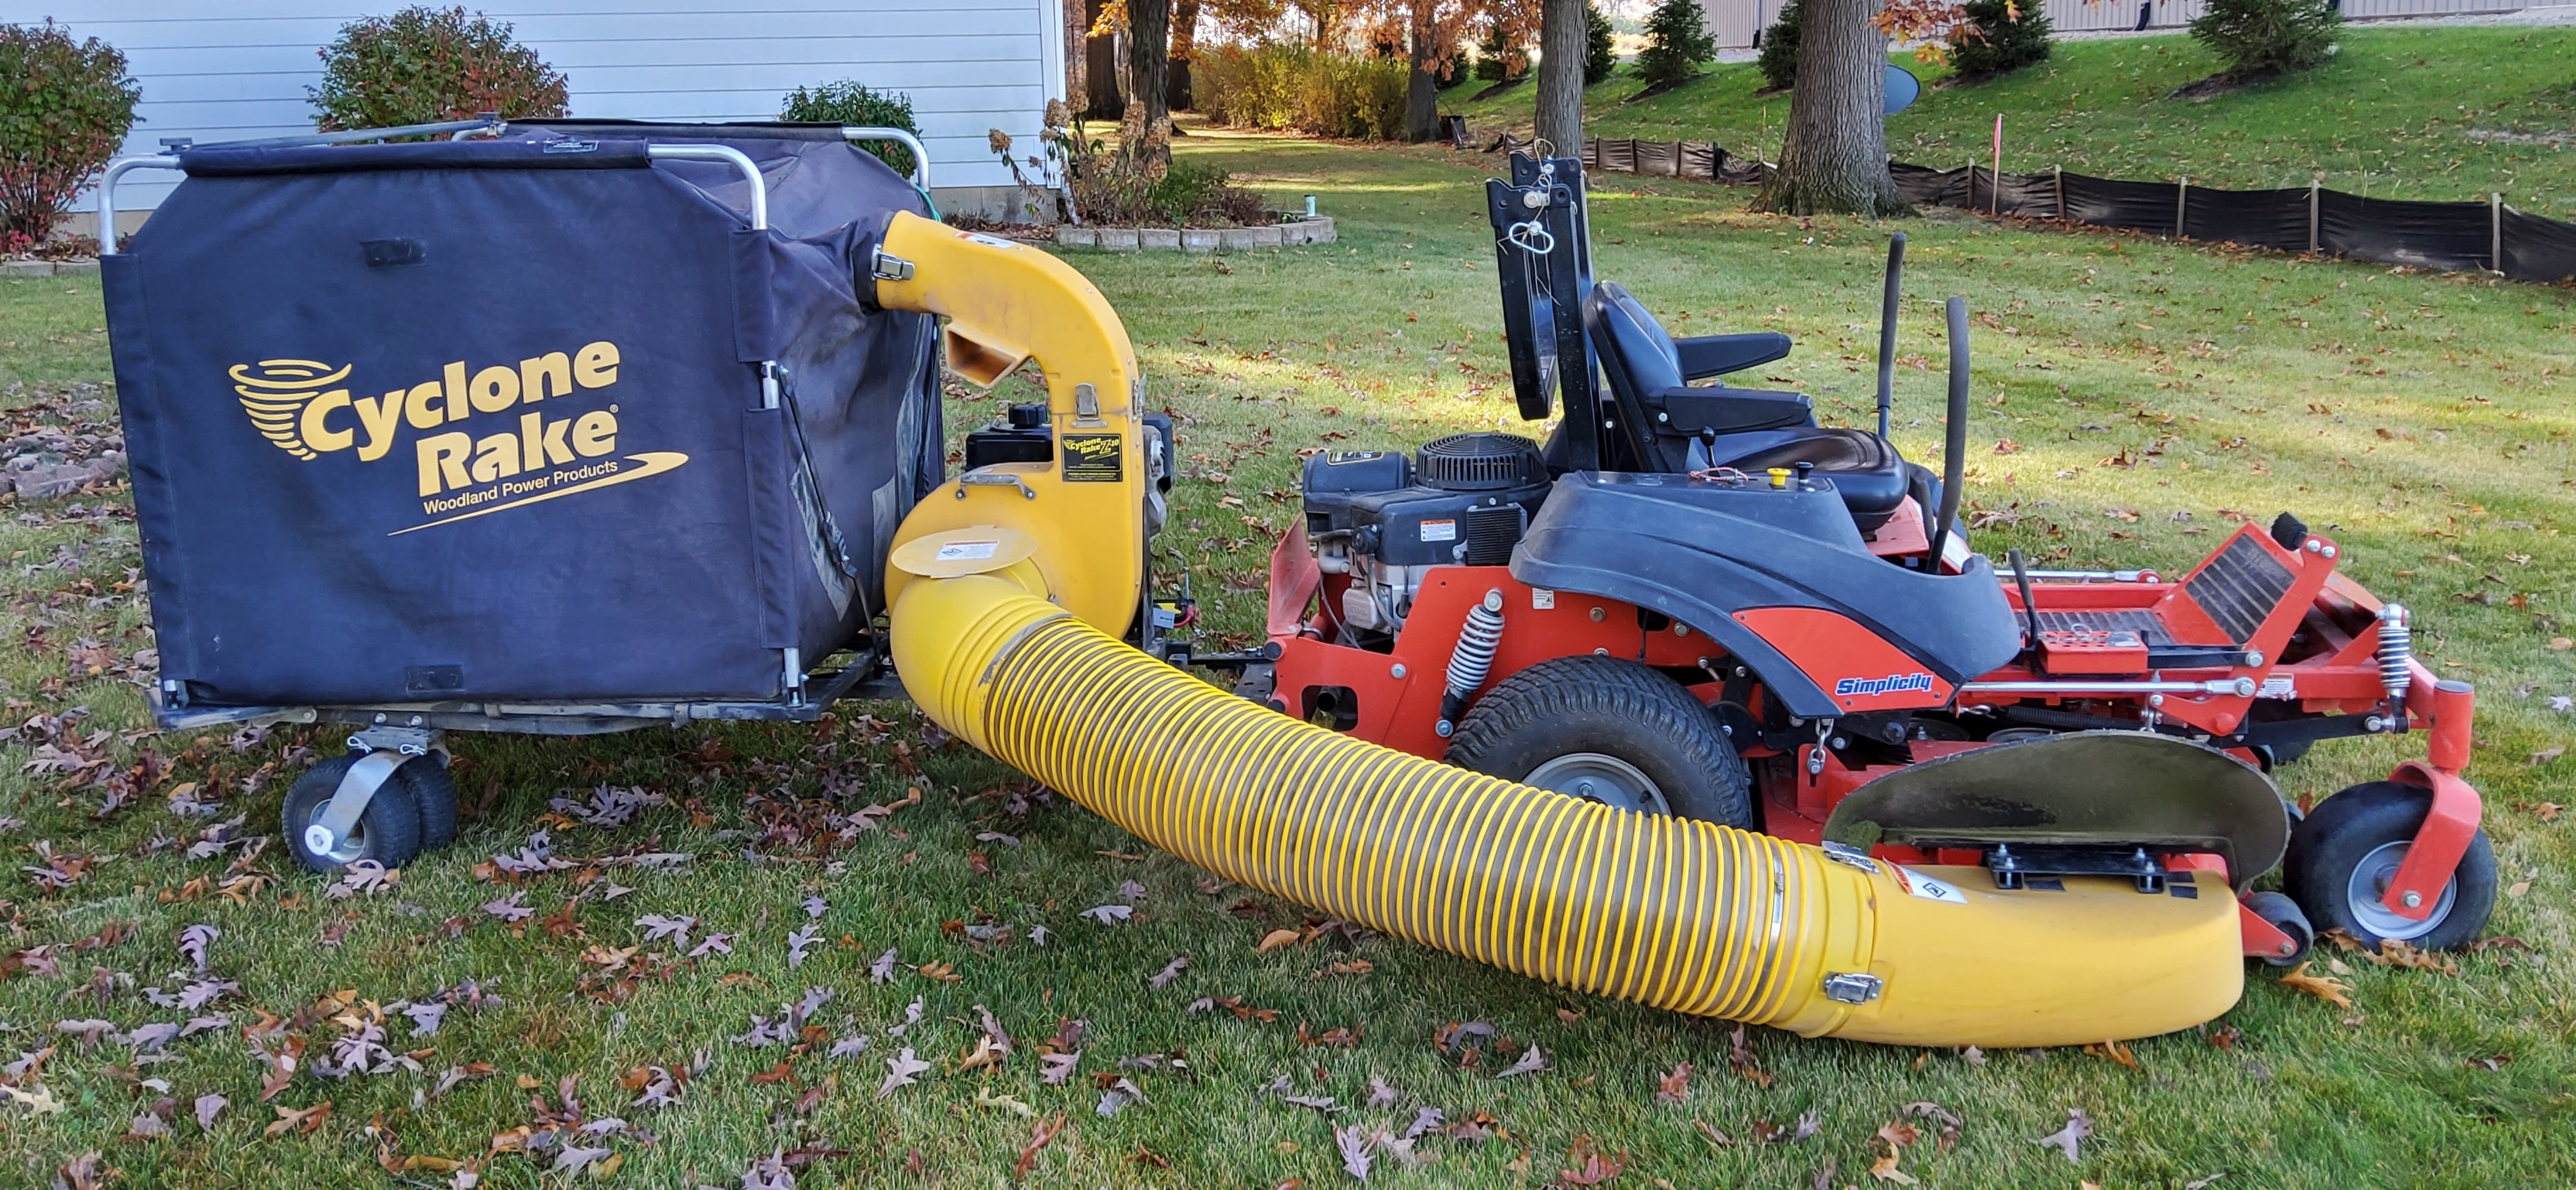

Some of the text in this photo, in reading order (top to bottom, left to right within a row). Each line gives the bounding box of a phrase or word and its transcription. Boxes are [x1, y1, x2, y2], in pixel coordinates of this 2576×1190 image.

[300, 341, 620, 462] Cyclone
[1070, 438, 1101, 451] Cyclone
[1080, 445, 1101, 454] Rake
[424, 461, 618, 514] Woodland Power Products
[1835, 673, 1933, 696] Simplicity
